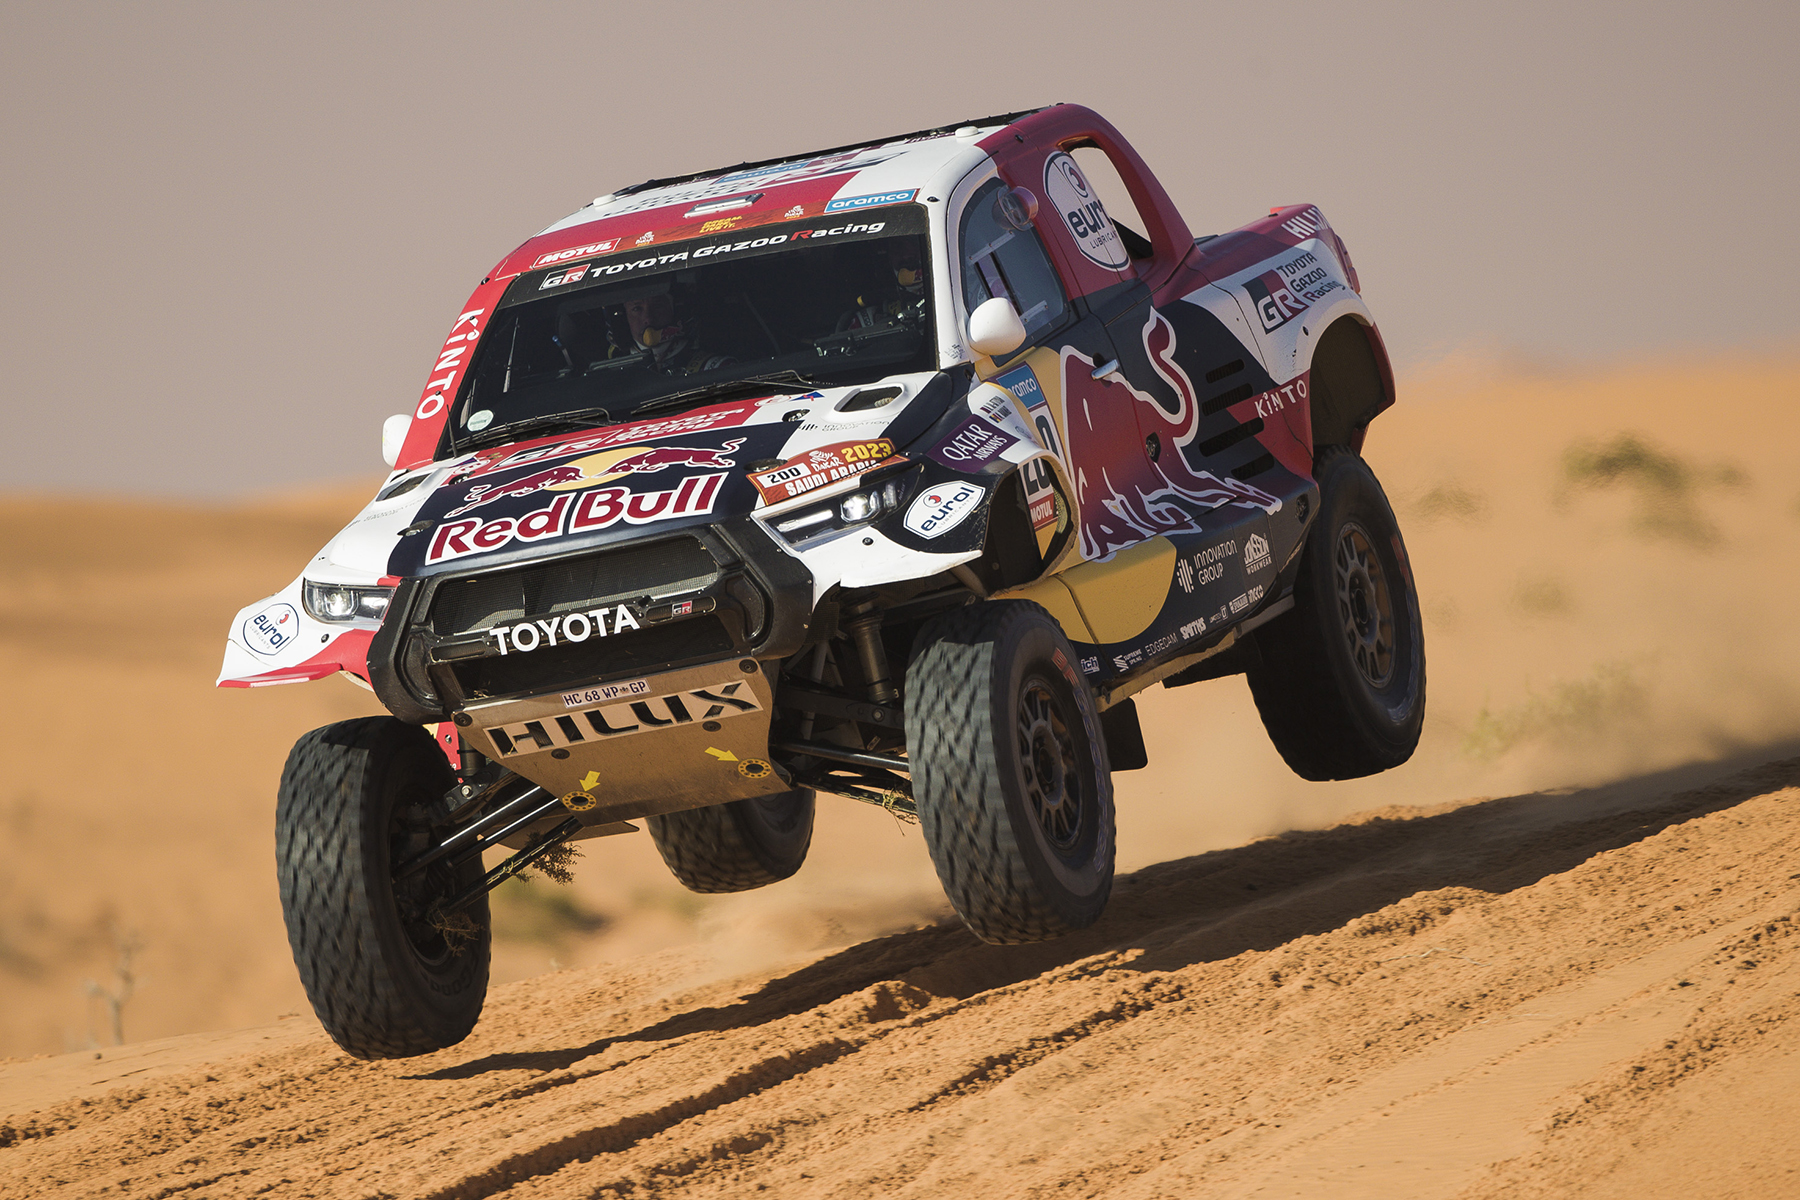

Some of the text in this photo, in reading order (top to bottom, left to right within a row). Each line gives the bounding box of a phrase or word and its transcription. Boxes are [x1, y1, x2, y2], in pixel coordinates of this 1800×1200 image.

[832, 192, 909, 208] aramco
[539, 242, 612, 264] MOTUL
[542, 221, 885, 289] GR TOYOTA GAZOO Racing
[1276, 252, 1318, 278] TOYOTA
[1289, 267, 1327, 293] GAZOO
[1302, 281, 1346, 302] Racing
[1258, 288, 1307, 330] GR
[841, 443, 892, 462] 2023
[942, 424, 993, 461] QATAR
[973, 435, 1008, 461] AIRWAYS
[767, 467, 800, 484] 200
[811, 456, 844, 472] DAKAR
[785, 460, 881, 496] SAUDI ARABIA
[425, 492, 577, 565] Red
[569, 472, 729, 534] Bull
[920, 487, 974, 531] eurol
[1030, 501, 1053, 521] MOTUL
[1193, 539, 1238, 569] INNOVATION
[1198, 562, 1224, 586] GROUP
[673, 603, 692, 615] GR
[253, 614, 290, 649] eurol
[489, 603, 640, 656] TOYOTA
[1145, 633, 1178, 656] EDGECAM
[563, 681, 646, 706] HC 68 WP GP
[487, 682, 761, 756] HILUX
